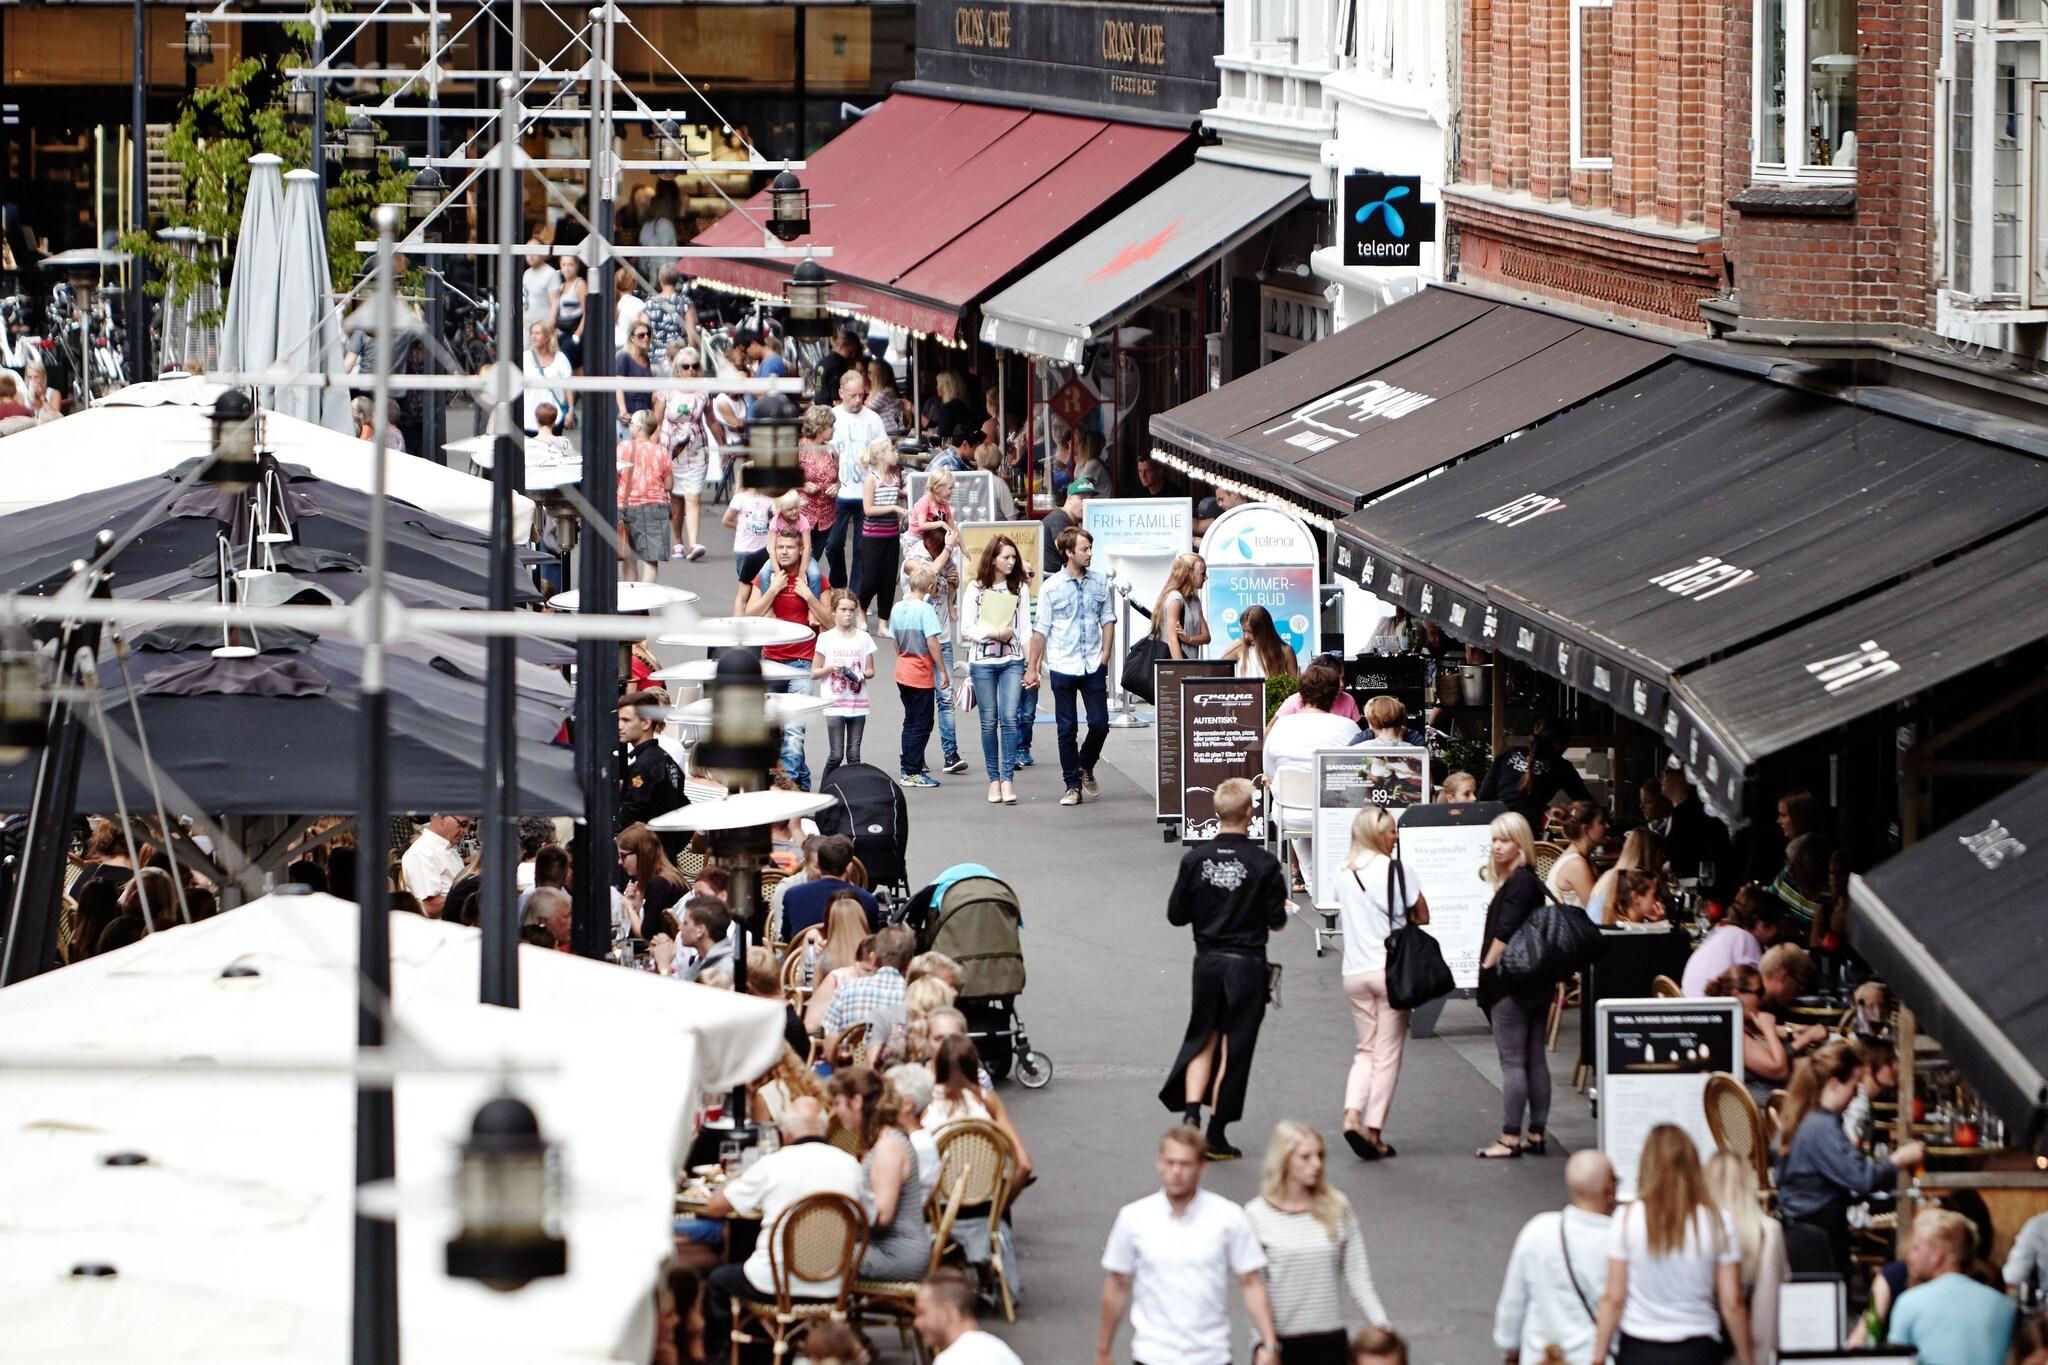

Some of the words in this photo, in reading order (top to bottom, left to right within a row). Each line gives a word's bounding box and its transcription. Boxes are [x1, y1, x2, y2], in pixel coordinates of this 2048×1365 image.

[956, 7, 984, 47] CROSS
[1102, 20, 1135, 62] CROSS
[1357, 239, 1410, 256] telenor
[1093, 514, 1125, 528] FRI+
[1129, 513, 1183, 528] FAMILIE
[1254, 534, 1296, 548] telenor
[1230, 576, 1296, 591] SOMMER-
[1237, 592, 1286, 607] TILBUD
[1193, 716, 1238, 725] AUTENTISK?
